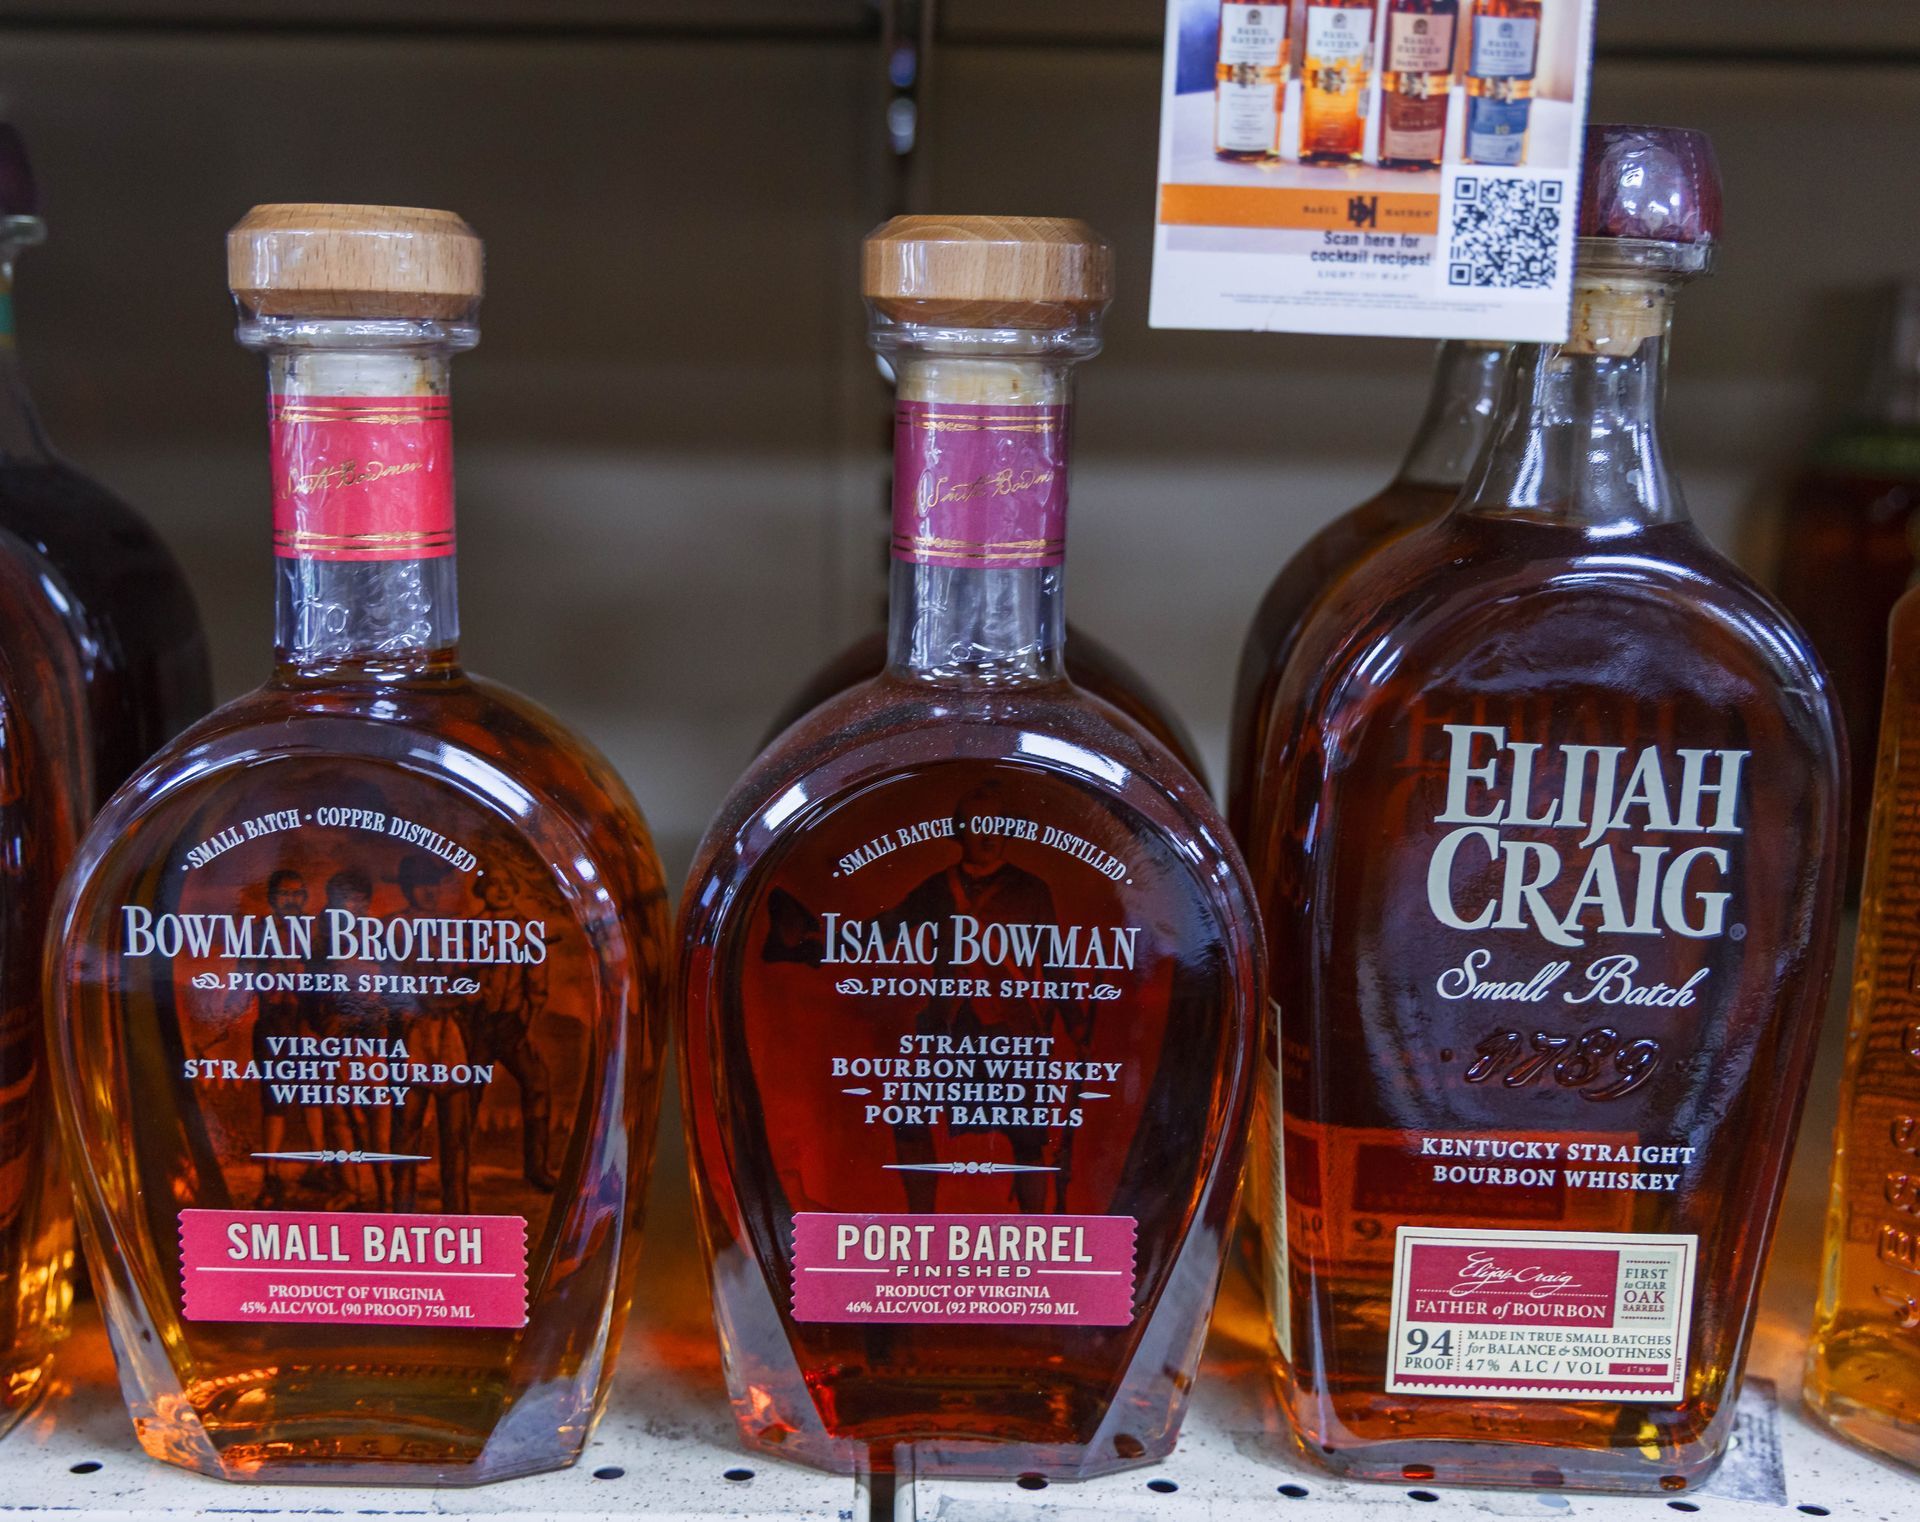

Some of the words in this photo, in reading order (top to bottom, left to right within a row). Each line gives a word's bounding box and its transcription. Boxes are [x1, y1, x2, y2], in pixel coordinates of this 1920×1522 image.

[1324, 230, 1359, 246] Scan
[1363, 232, 1396, 247] here
[1401, 232, 1421, 248] for
[1310, 249, 1368, 264] cocktail
[1373, 250, 1431, 268] recipes!
[1433, 723, 1752, 849] ELIJAH
[187, 827, 246, 870] SMALL
[242, 808, 302, 840] BATCH
[317, 806, 385, 833] COPPER
[388, 817, 477, 874] DISTILLED
[838, 833, 898, 876] SMALL
[896, 817, 955, 847] BATCH
[970, 815, 1038, 841] COPPER
[1040, 826, 1127, 882] DISTILLED
[121, 905, 315, 960] BOWMAN
[325, 908, 547, 965] BROTHERS
[820, 912, 939, 965] ISAAC
[949, 915, 1142, 971] BOWMAN
[227, 972, 352, 994] PIONEER
[358, 974, 449, 996] SPIRIT
[871, 978, 992, 998] PIONEER
[1000, 980, 1091, 1001] SPIRIT
[1436, 948, 1570, 1002] Small
[1563, 953, 1711, 1009] Batch
[267, 1036, 410, 1060] VIRGINIA
[899, 1034, 1055, 1057] STRAIGHT
[184, 1059, 341, 1082] STRAIGHT
[349, 1062, 495, 1085] BOURBON
[831, 1058, 976, 1079] BOURBON
[984, 1060, 1123, 1083] WHISKEY
[1464, 1027, 1661, 1102] 1789
[271, 1083, 411, 1107] WHISKEY
[881, 1081, 1027, 1104] FINISHED
[1034, 1083, 1069, 1104] IN
[865, 1104, 944, 1126] PORT
[950, 1106, 1084, 1128] BARRELS
[1421, 1136, 1562, 1161] KENTUCKY
[1566, 1141, 1697, 1165] STRAIGHT
[1432, 1164, 1559, 1187] BOURBON
[1564, 1168, 1681, 1192] WHISKEY
[227, 1222, 350, 1262] SMALL
[363, 1226, 483, 1264] BATCH
[836, 1224, 936, 1261] PORT
[949, 1225, 1093, 1263] BARREL
[896, 1265, 1032, 1278] FINISHED
[1514, 1265, 1582, 1298] Craig
[1625, 1268, 1668, 1280] FIRST
[268, 1285, 344, 1299] PRODUCT
[348, 1286, 369, 1299] OF
[372, 1287, 444, 1301] VIRGINIA
[875, 1285, 951, 1298] PRODUCT
[954, 1285, 976, 1298] OF
[978, 1286, 1050, 1299] VIRGINIA
[1624, 1281, 1633, 1289] to
[1634, 1280, 1667, 1290] CHAR
[846, 1301, 873, 1313] 46%
[875, 1301, 943, 1314] ALC/VOL
[946, 1301, 966, 1316] (92
[969, 1301, 1027, 1316] PROOF)
[1030, 1302, 1051, 1315] 750
[1054, 1303, 1079, 1316] ML
[1622, 1304, 1665, 1313] BARRELS
[1623, 1290, 1665, 1304] OAK
[240, 1301, 267, 1314] 45%
[269, 1301, 338, 1316] ALC/VOL
[341, 1302, 361, 1318] (90
[364, 1303, 423, 1319] PROOF)
[425, 1304, 448, 1318] 750
[450, 1305, 475, 1319] ML
[1415, 1299, 1487, 1315] FATHER
[1492, 1302, 1512, 1319] of
[1513, 1303, 1607, 1318] BOURBON
[1407, 1328, 1454, 1357] 94
[1467, 1330, 1508, 1341] MADE
[1510, 1331, 1526, 1341] IN
[1529, 1332, 1563, 1343] TRUE
[1566, 1333, 1609, 1344] SMALL
[1612, 1334, 1672, 1346] BATCHES
[1466, 1342, 1485, 1356] for
[1487, 1343, 1556, 1356] BALANCE
[1558, 1345, 1570, 1356] &
[1572, 1346, 1672, 1359] SMOOTHNESS
[1404, 1356, 1455, 1370] PROOF
[1465, 1359, 1500, 1372] 47%
